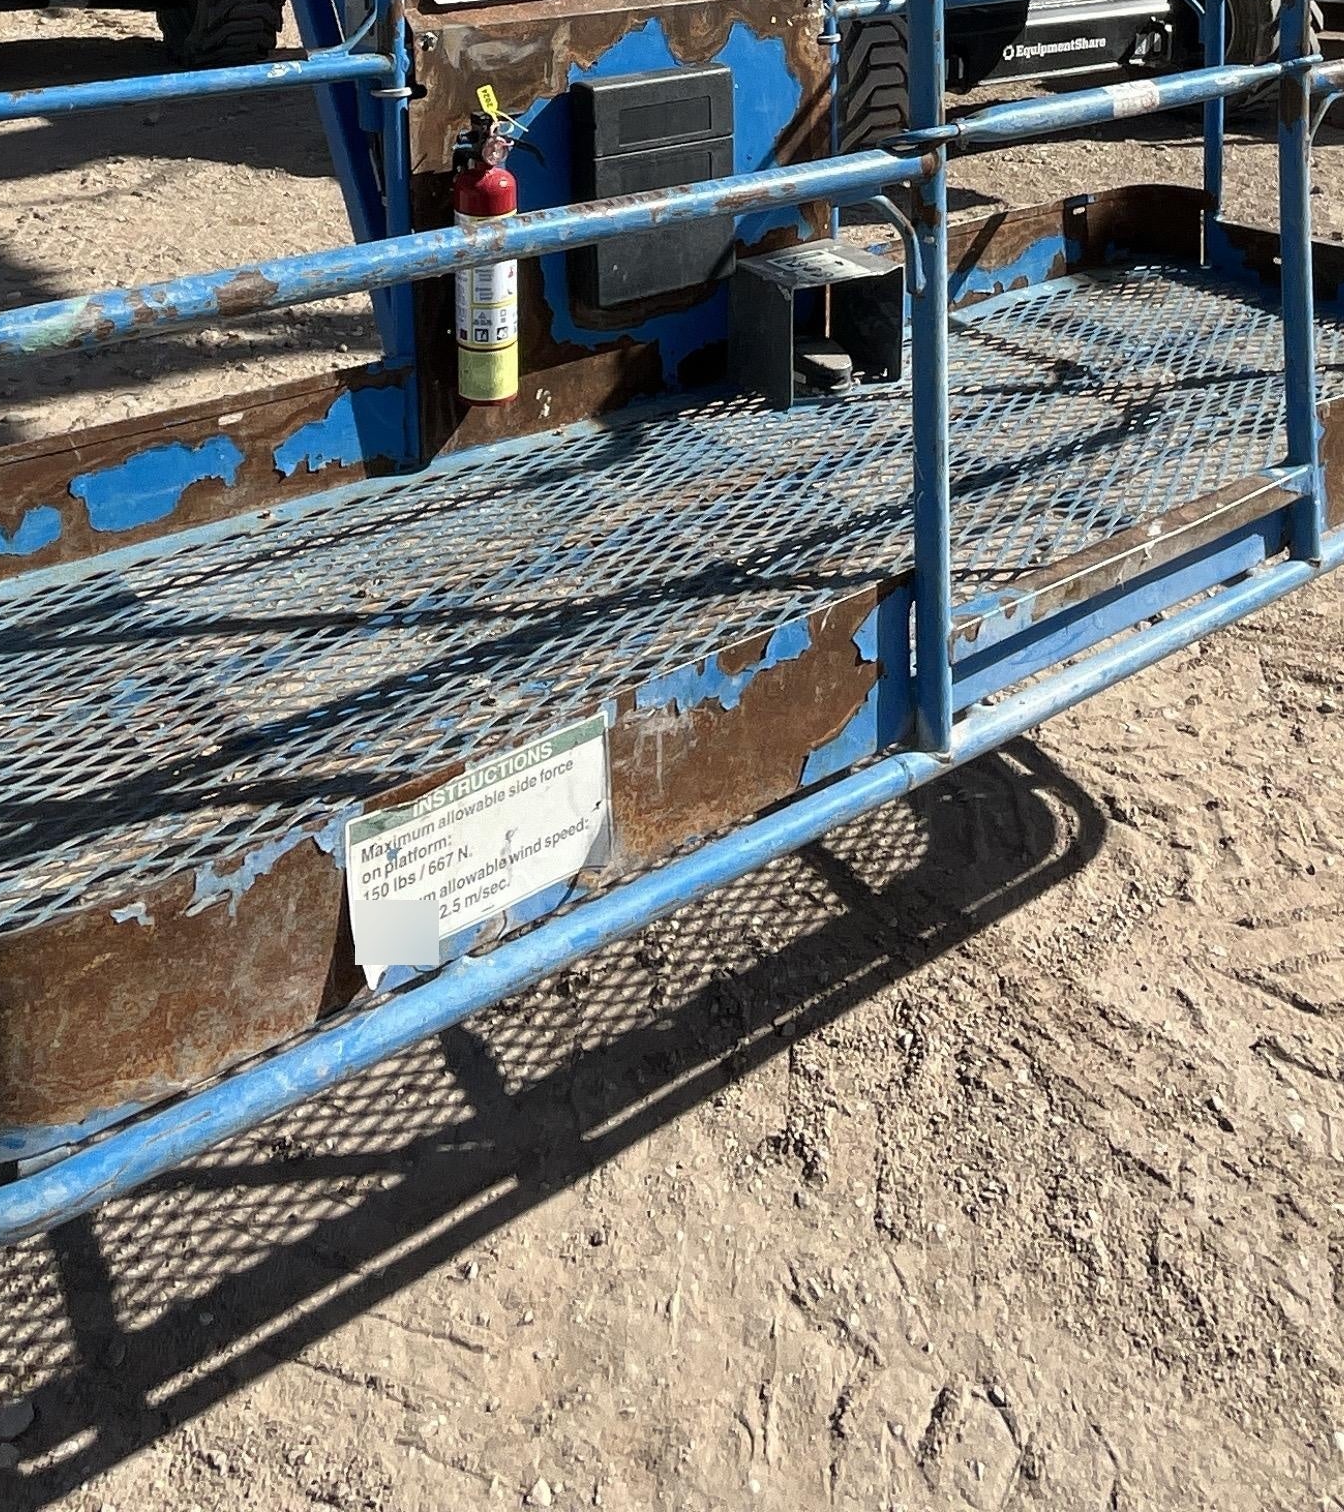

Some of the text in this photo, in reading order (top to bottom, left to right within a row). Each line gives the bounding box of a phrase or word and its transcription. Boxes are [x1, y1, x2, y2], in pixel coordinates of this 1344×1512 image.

[1016, 37, 1107, 59] EquipmentShare
[413, 741, 553, 818] INSTRUCTIONS
[360, 758, 574, 864] Maximum allowable side force
[361, 834, 453, 885] on platform:
[363, 881, 390, 901] 150
[393, 869, 417, 890] lbs
[427, 856, 452, 876] 667
[439, 817, 589, 899] allowable wind speed:
[439, 904, 461, 920] 2.5
